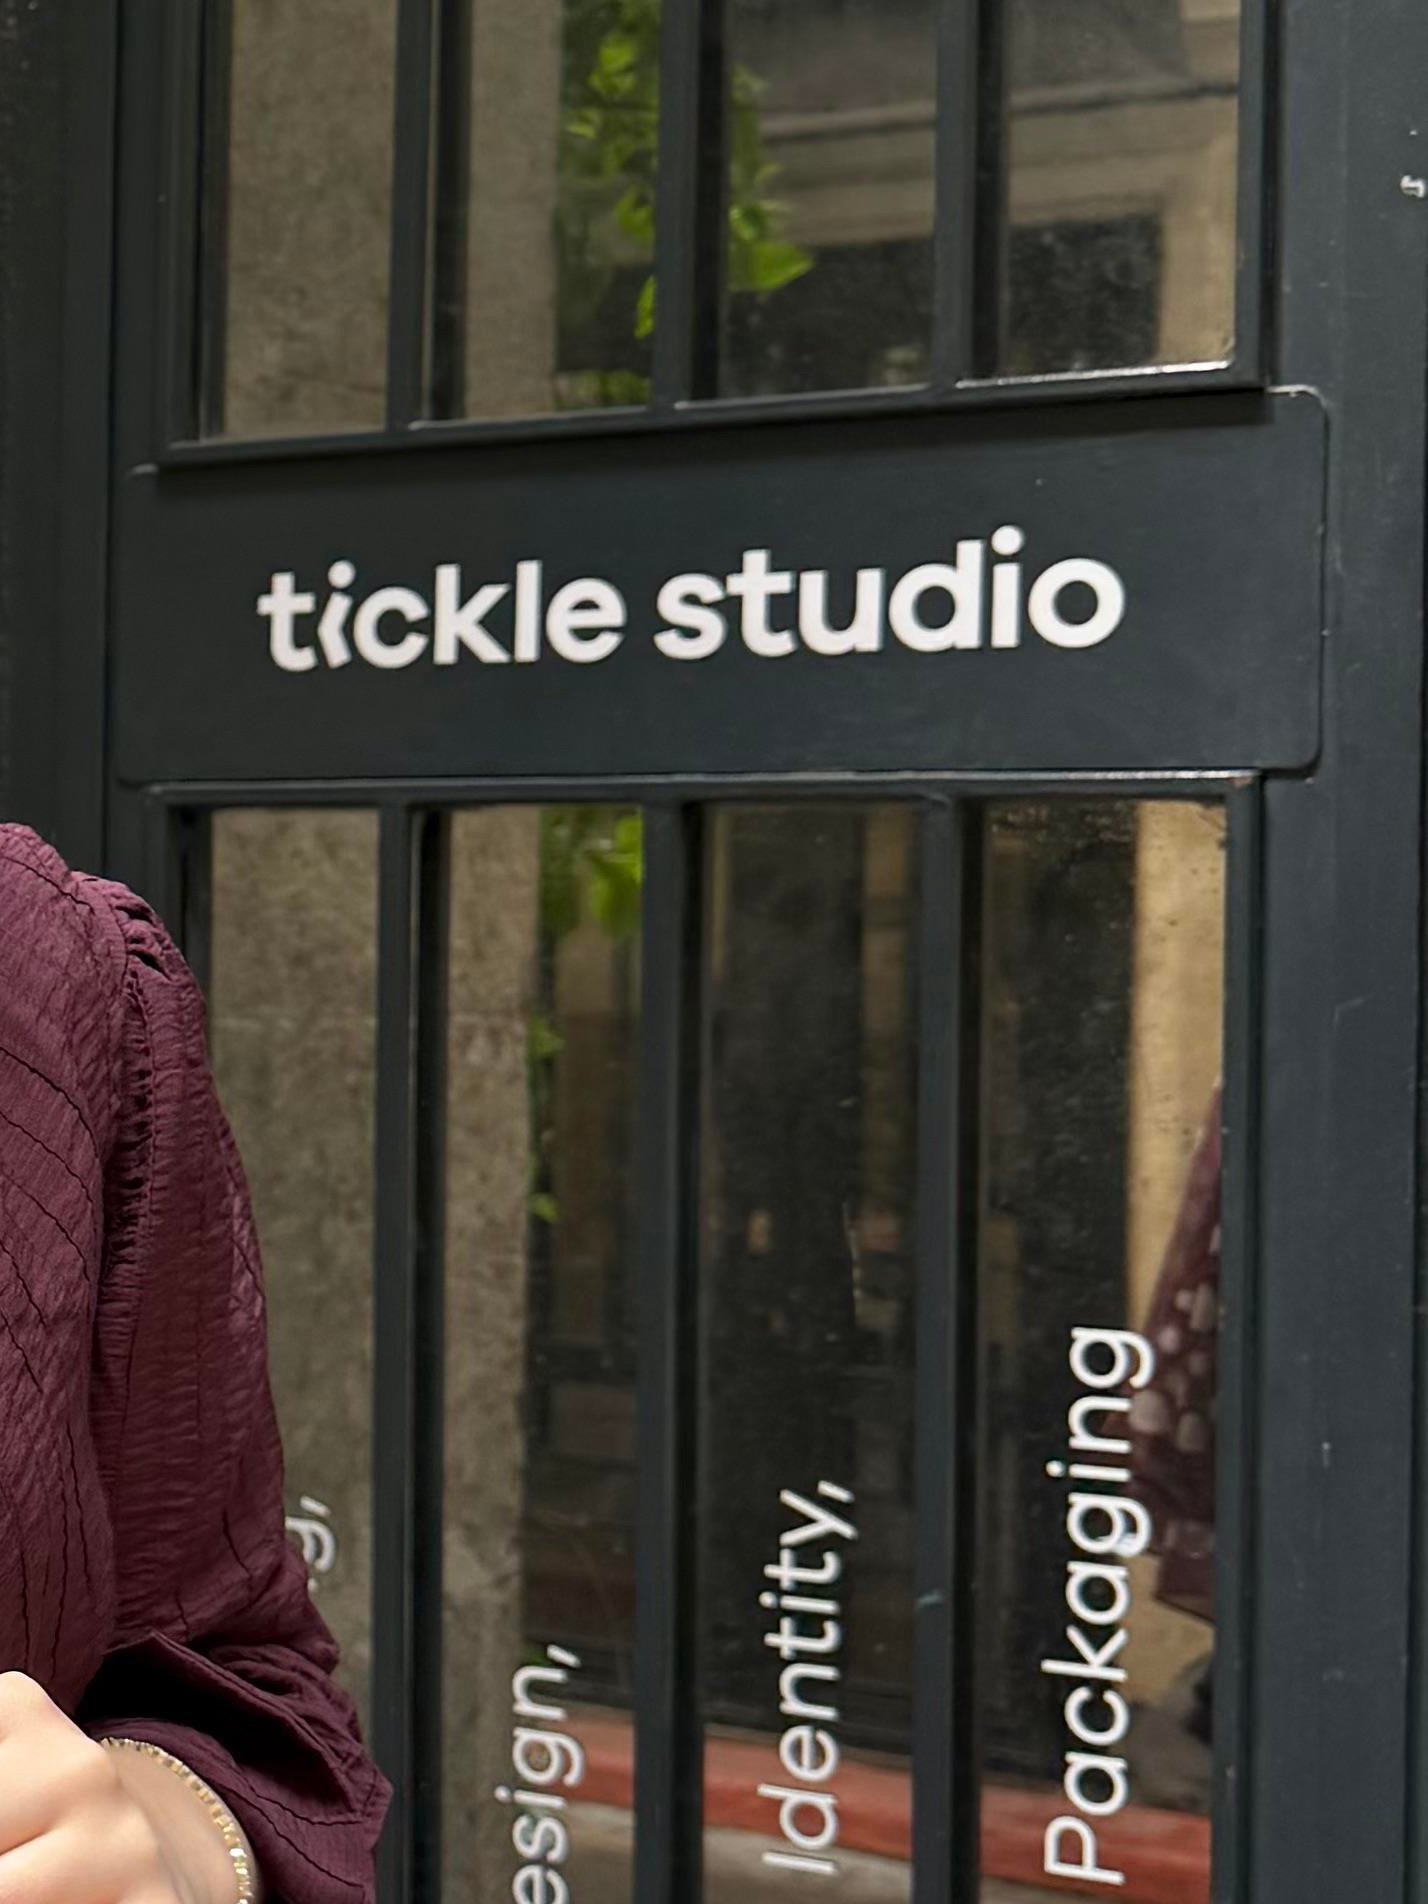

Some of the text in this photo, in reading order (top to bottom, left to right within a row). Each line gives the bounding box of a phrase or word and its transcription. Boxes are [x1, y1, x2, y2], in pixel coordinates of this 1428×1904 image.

[257, 526, 1126, 672] tickle studio
[757, 1481, 859, 1874] Identity,
[1042, 1327, 1155, 1885] Packaging
